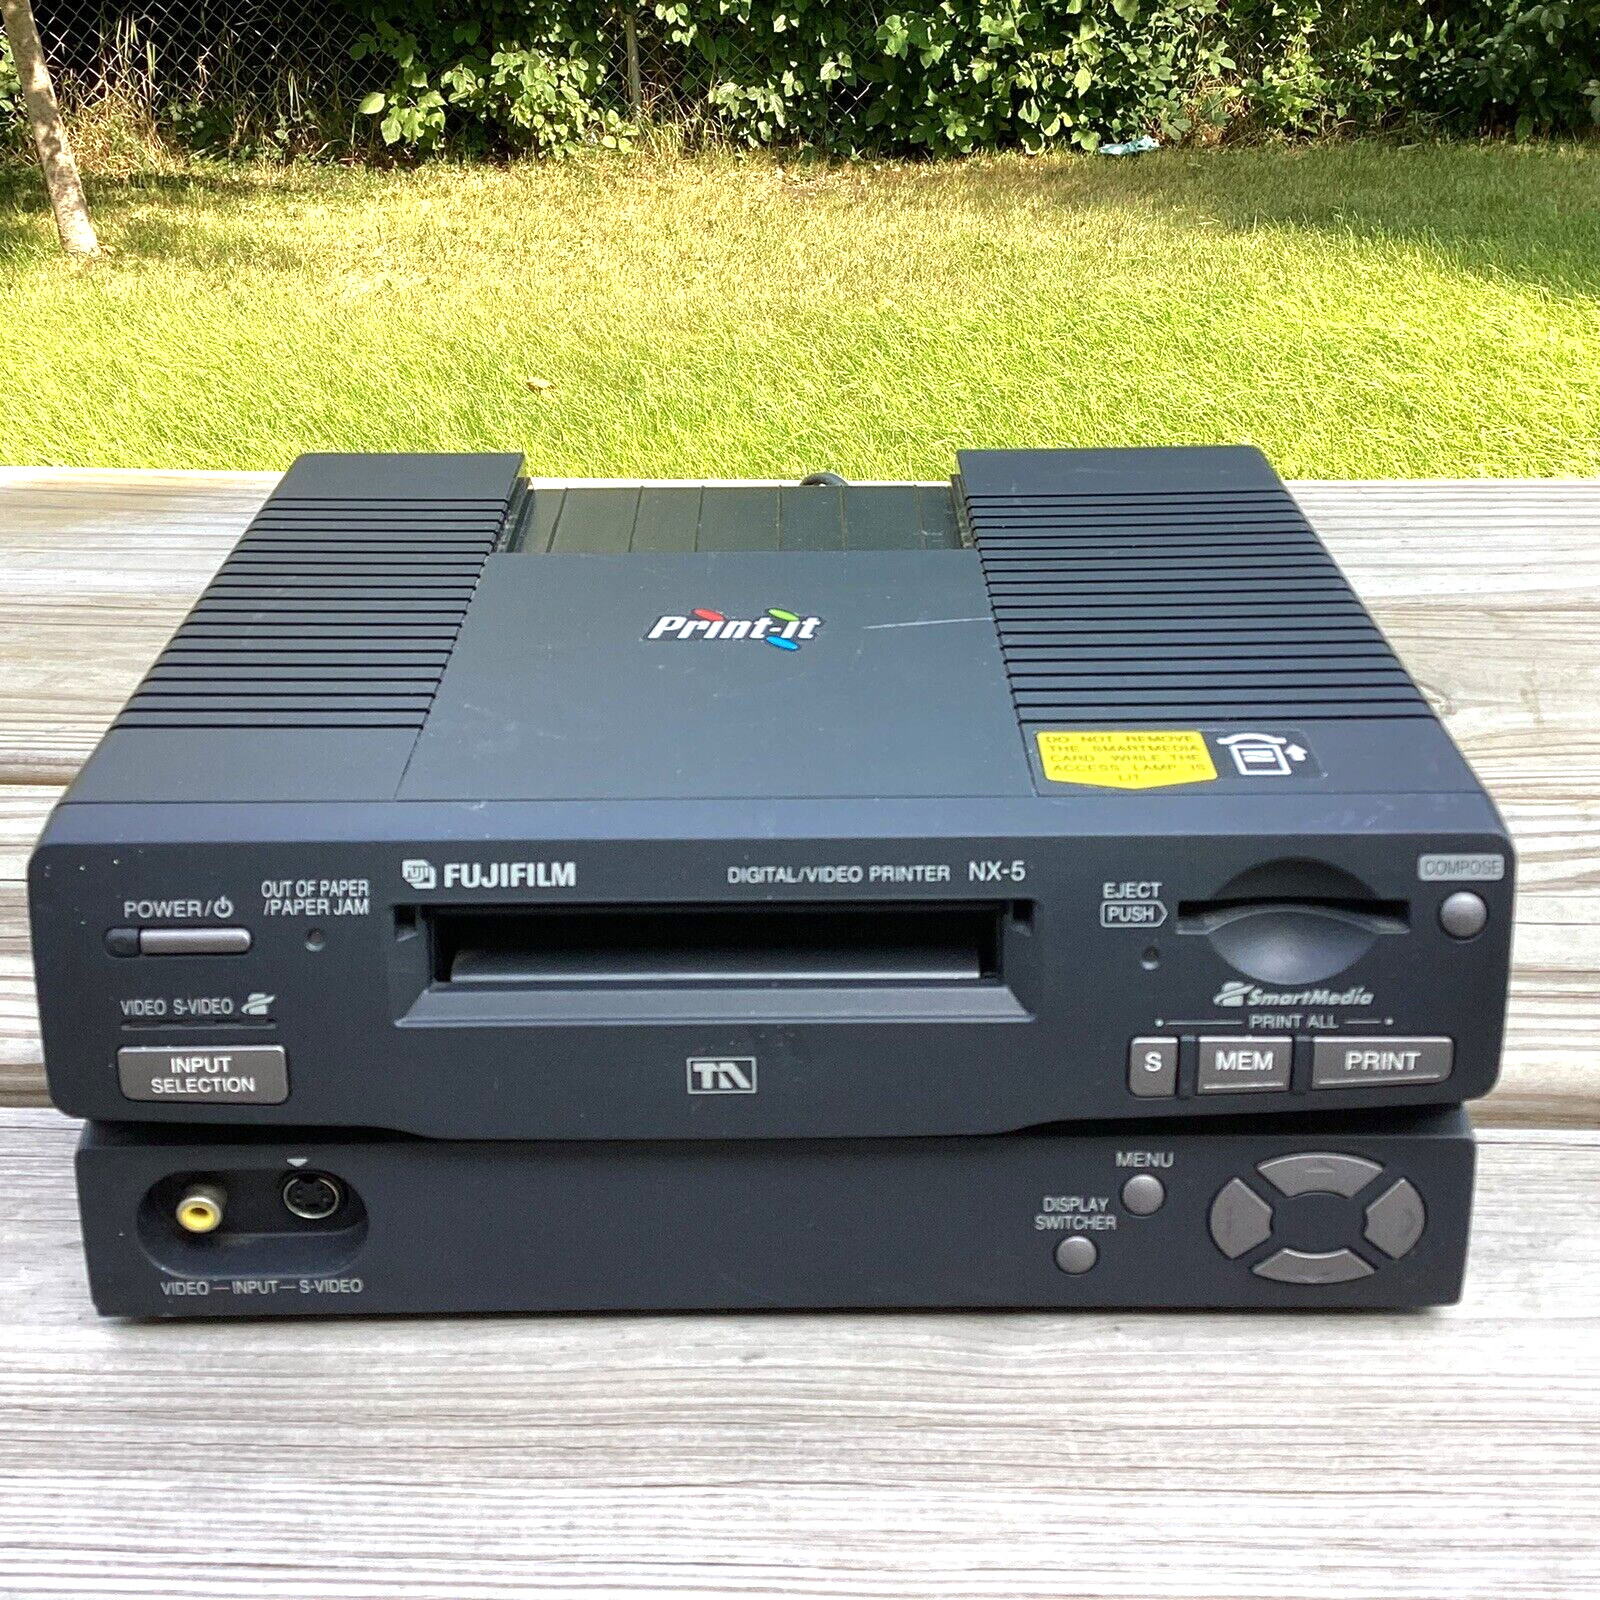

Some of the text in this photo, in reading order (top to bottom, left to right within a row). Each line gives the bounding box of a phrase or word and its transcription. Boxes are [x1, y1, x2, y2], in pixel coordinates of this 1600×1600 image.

[648, 610, 822, 640] Print-it
[1046, 735, 1070, 743] DO
[1125, 735, 1194, 743] REMOVE
[1050, 745, 1079, 753] THE
[1050, 754, 1201, 762] CARD WHILE THE
[1053, 763, 1207, 773] ACCESS LAMP IS
[444, 862, 577, 888] FUJIFILM
[727, 860, 1027, 883] DIGITAL/VIDEO PRINTER NX-5
[1423, 859, 1501, 876] COMPOSE
[261, 880, 370, 898] OUT OF PAPER
[1102, 882, 1163, 898] EJECT
[263, 899, 370, 916] /PAPER JAM
[1107, 907, 1155, 922] PUSH
[1247, 987, 1374, 1006] SmartMedia
[120, 998, 234, 1015] VIDEO S-VIDEO
[1249, 1014, 1339, 1029] PRINT ALL
[170, 1057, 232, 1074] INPUT
[1144, 1053, 1163, 1072] S
[1215, 1051, 1274, 1072] MEM
[1344, 1051, 1421, 1072] PRINT
[151, 1077, 256, 1094] SELECTION
[1115, 1151, 1174, 1168] MENU
[1042, 1196, 1109, 1213] DISPLAY
[1035, 1215, 1117, 1231] SWITCHER
[160, 1279, 364, 1296] VIDEO INPUT S-VIDEO
